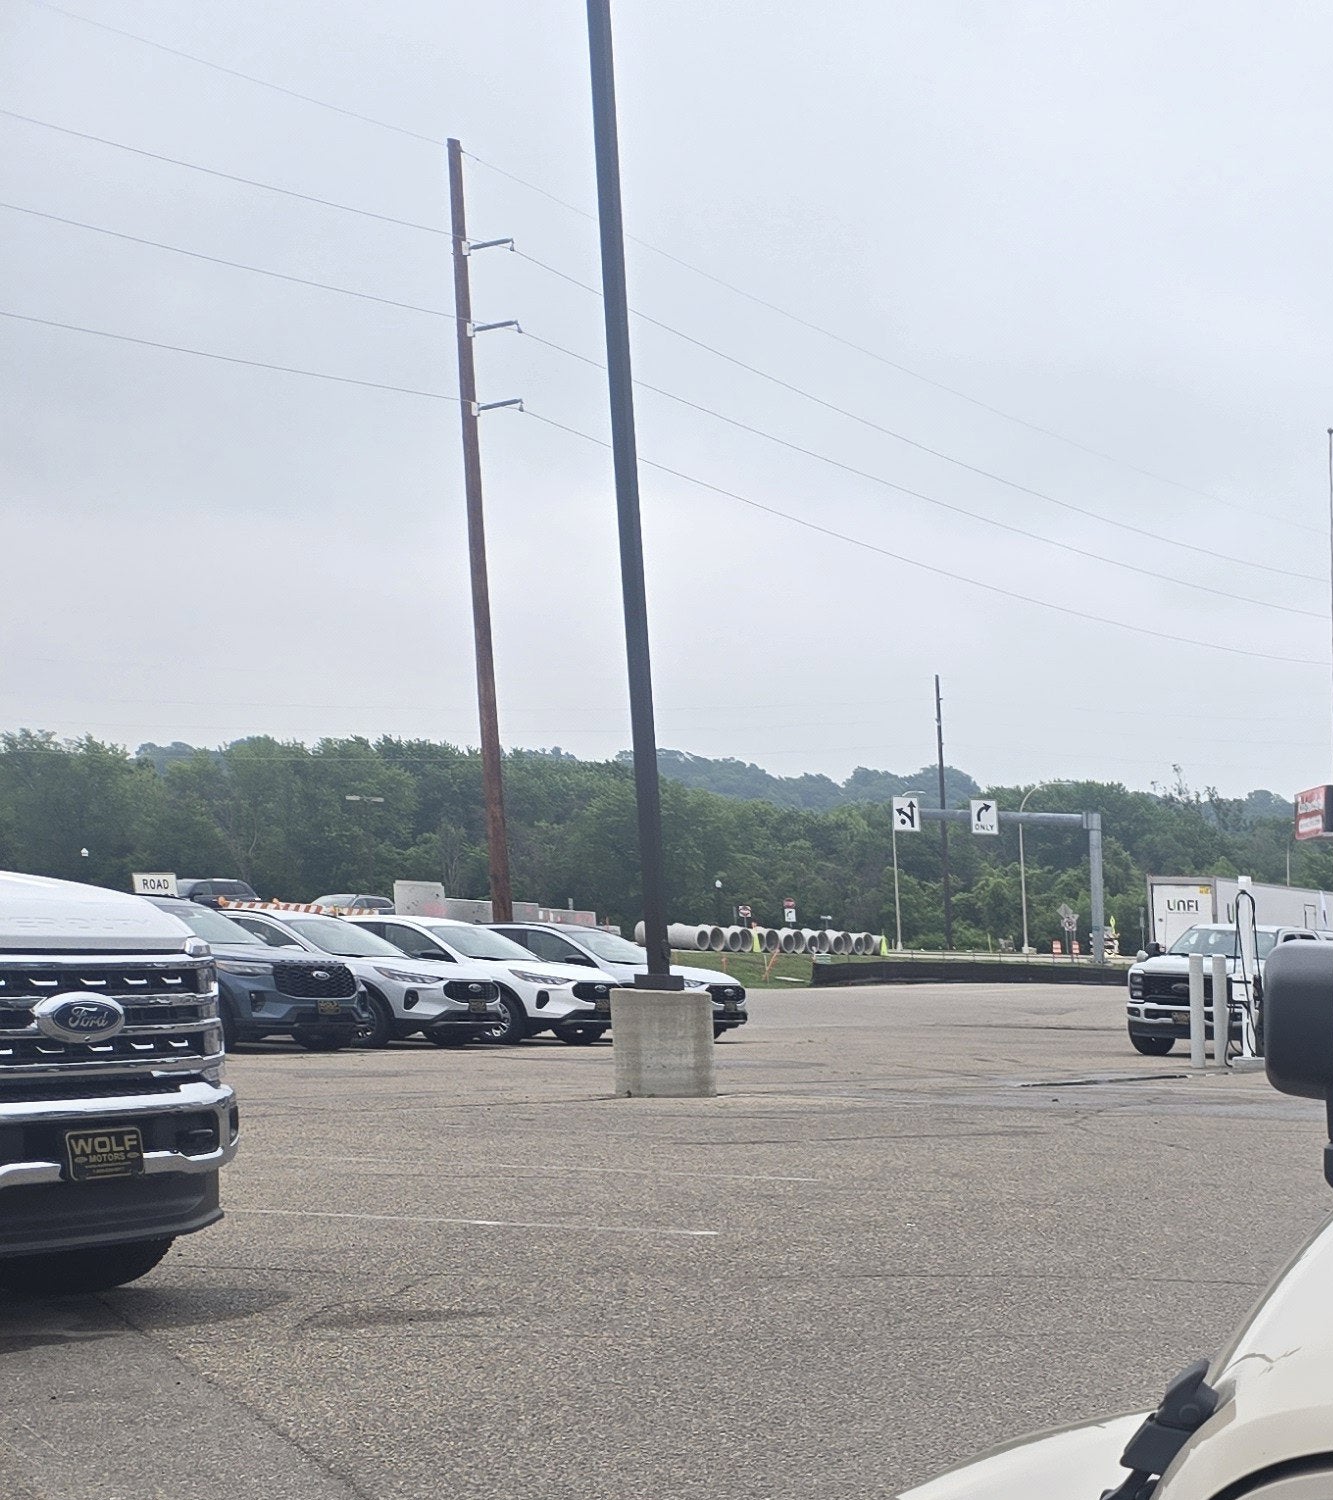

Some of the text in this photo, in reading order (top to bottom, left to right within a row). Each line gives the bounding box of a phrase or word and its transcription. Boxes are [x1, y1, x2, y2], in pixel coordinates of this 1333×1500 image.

[974, 823, 994, 832] ONLY
[142, 878, 170, 890] ROAD
[68, 1006, 109, 1028] Ford
[70, 1134, 138, 1155] WOLF
[88, 1152, 126, 1163] MOTORS
